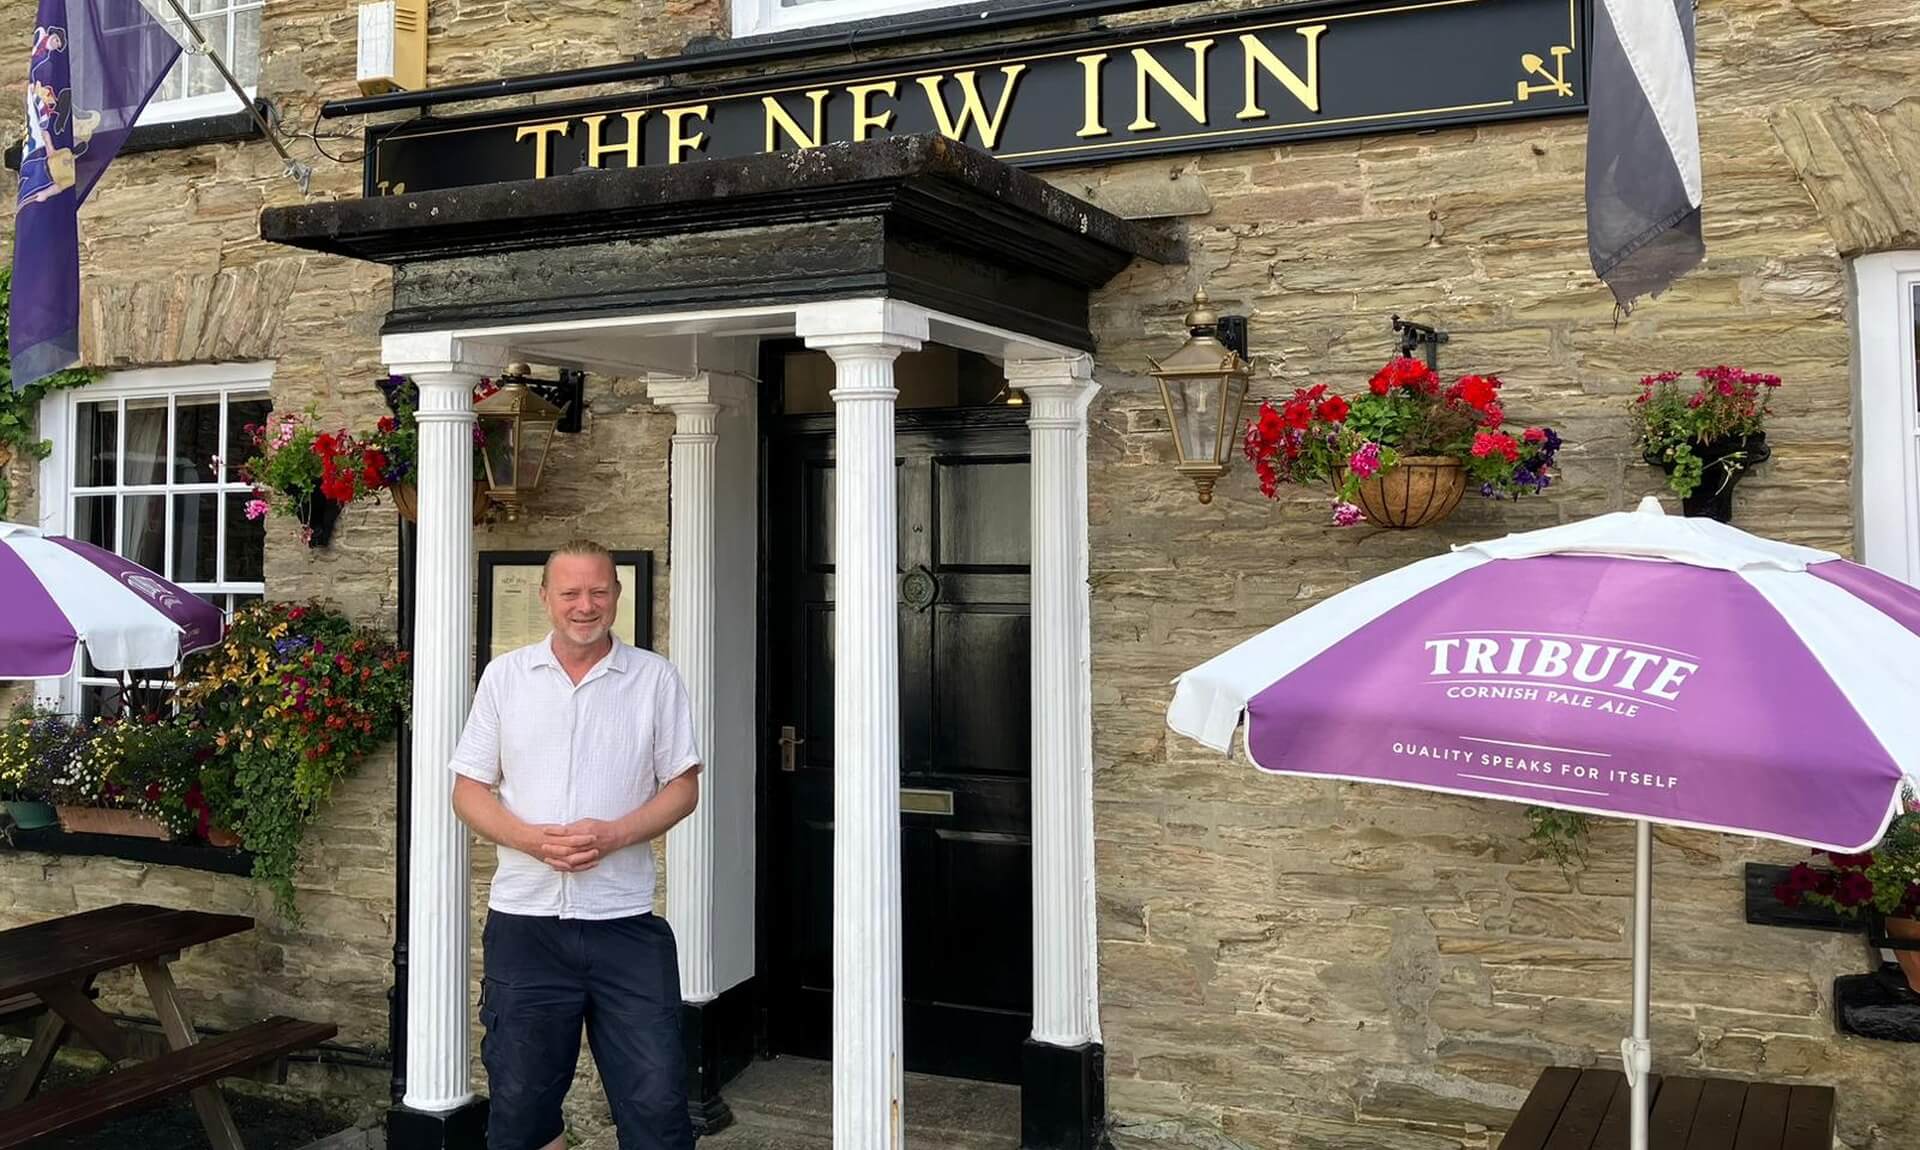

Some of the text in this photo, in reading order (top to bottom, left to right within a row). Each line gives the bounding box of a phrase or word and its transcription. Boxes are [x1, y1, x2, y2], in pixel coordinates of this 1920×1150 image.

[516, 24, 1328, 180] THE NEW INN
[1425, 637, 1699, 701] TRIBUTE
[1446, 686, 1639, 718] CORNISH PALE ALE
[1392, 742, 1679, 789] QUALITY SPEAKS FOR ITSELF
